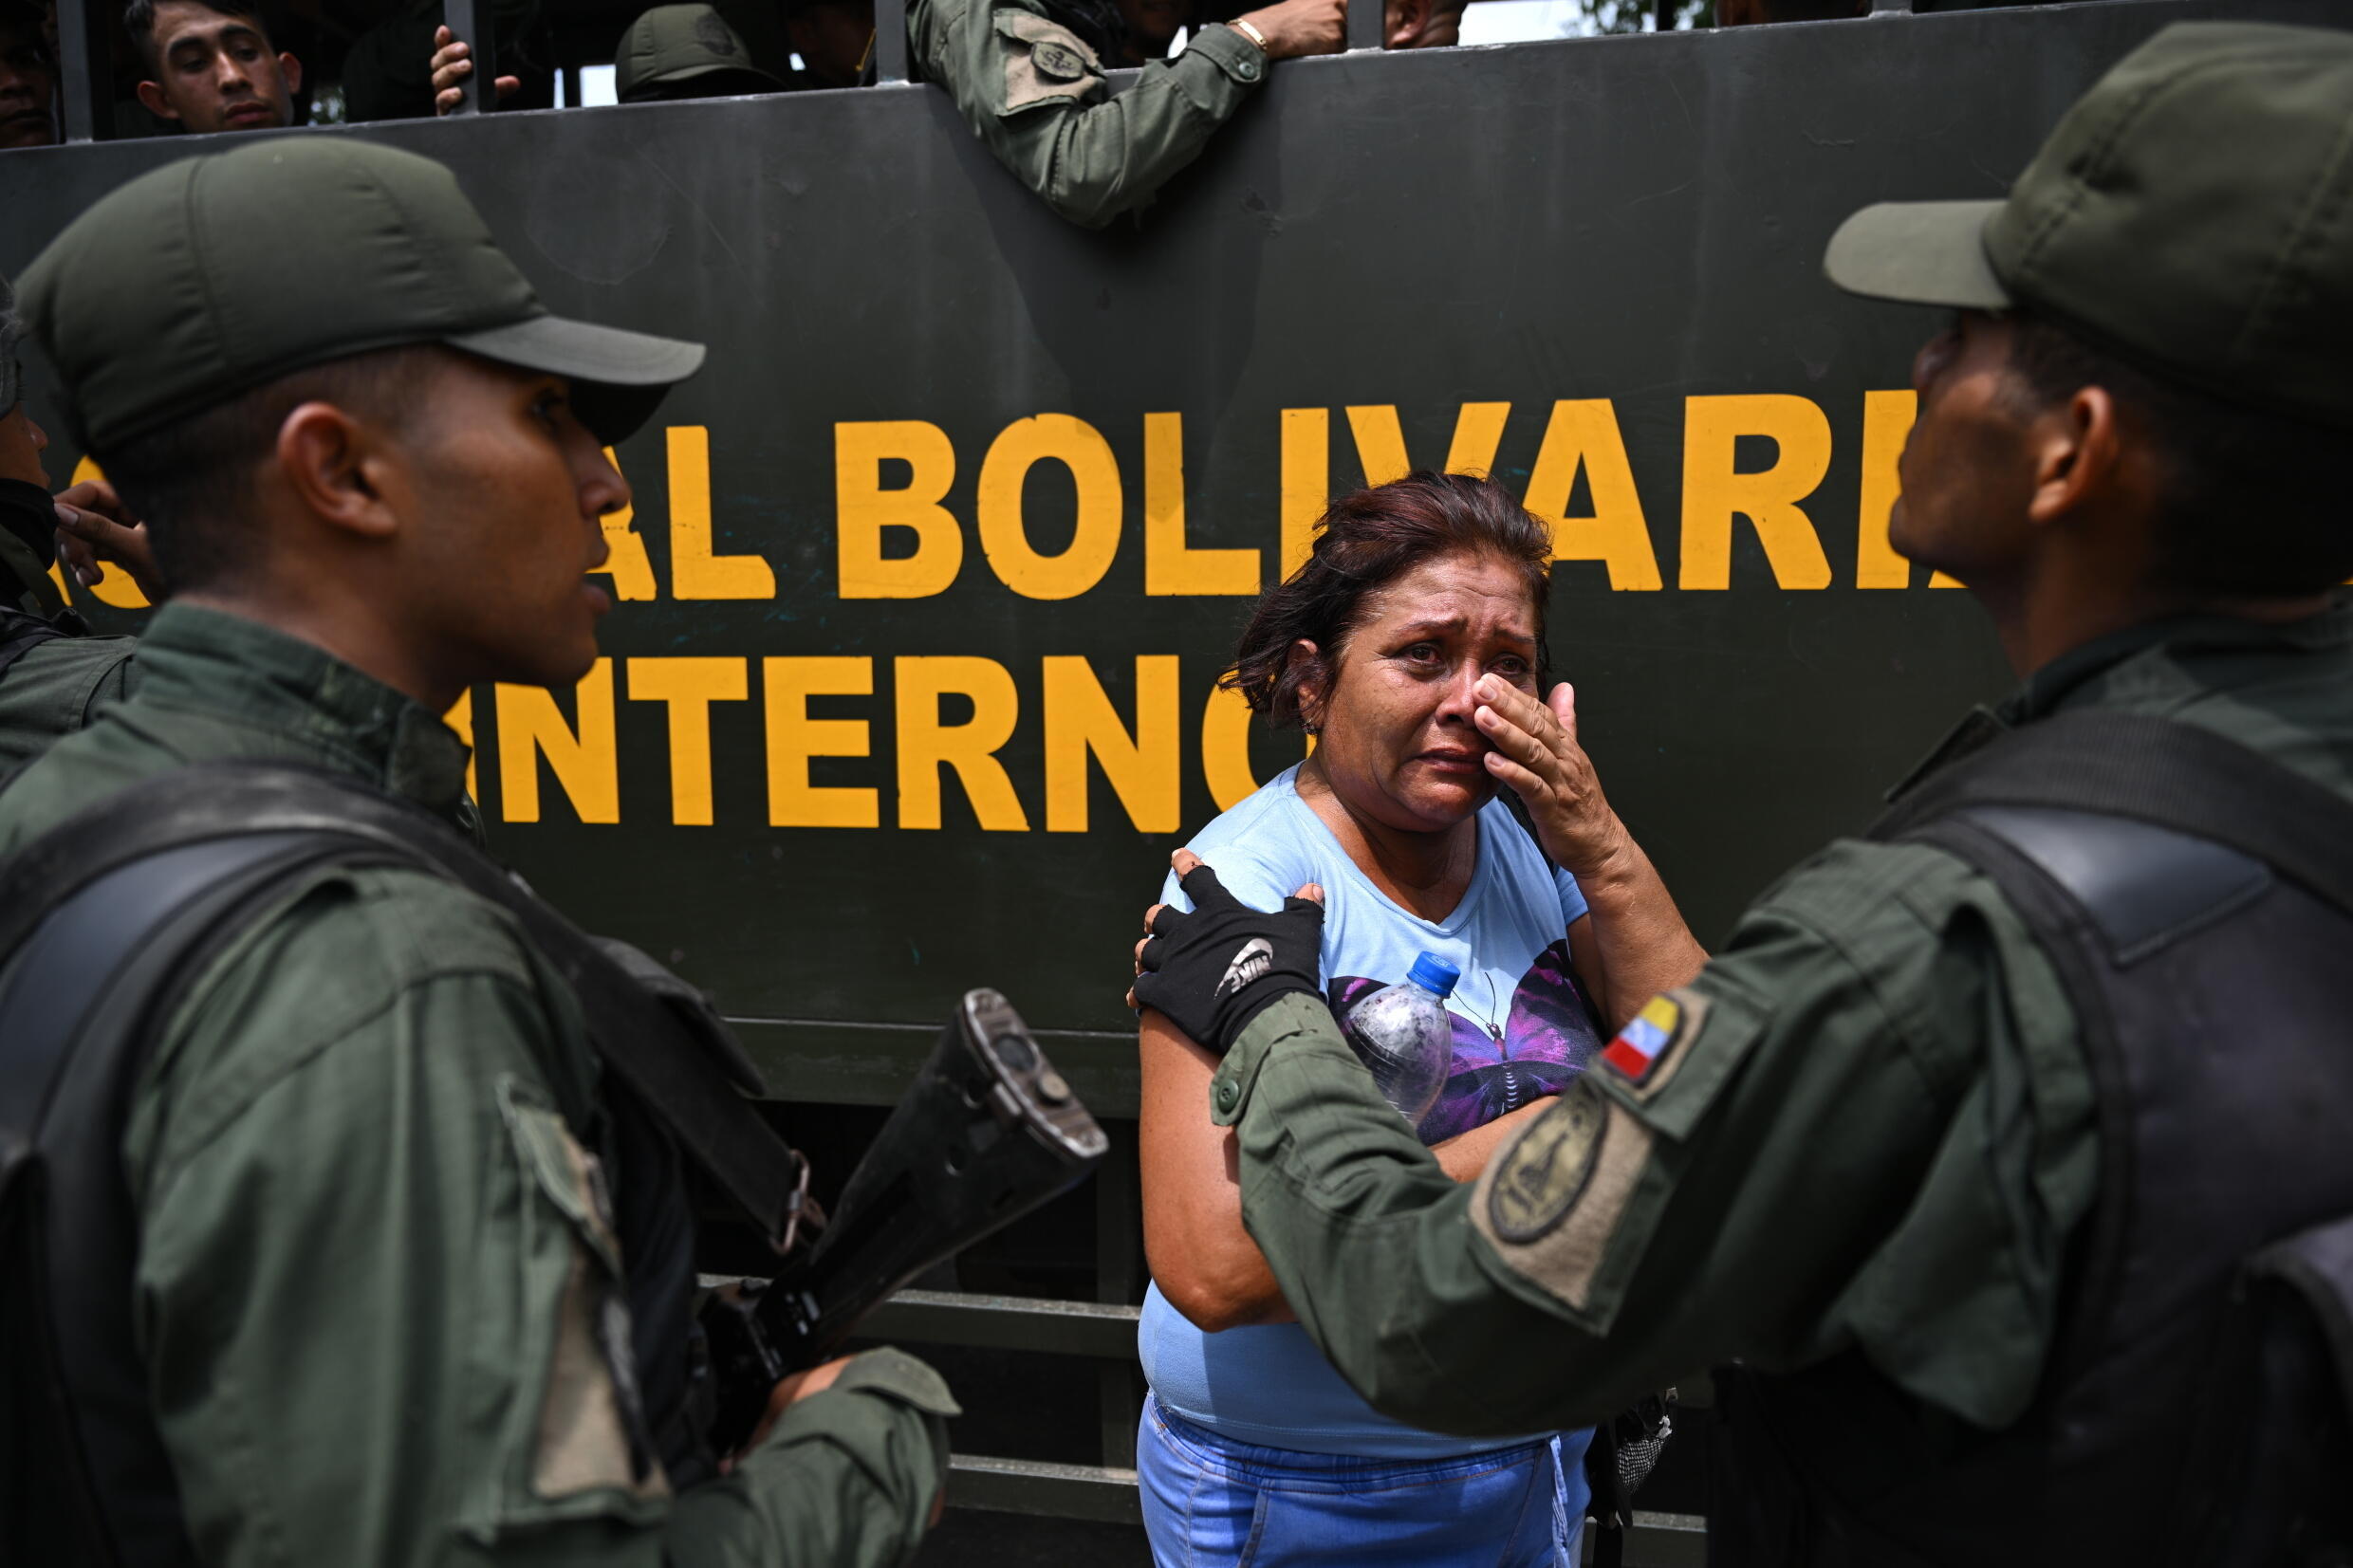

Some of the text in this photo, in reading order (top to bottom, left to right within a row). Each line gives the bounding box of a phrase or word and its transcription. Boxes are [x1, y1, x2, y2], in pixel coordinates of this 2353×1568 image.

[835, 390, 1968, 600] BOLIARI
[443, 655, 1317, 834] NTERN
[1231, 955, 1271, 993] NIKE
